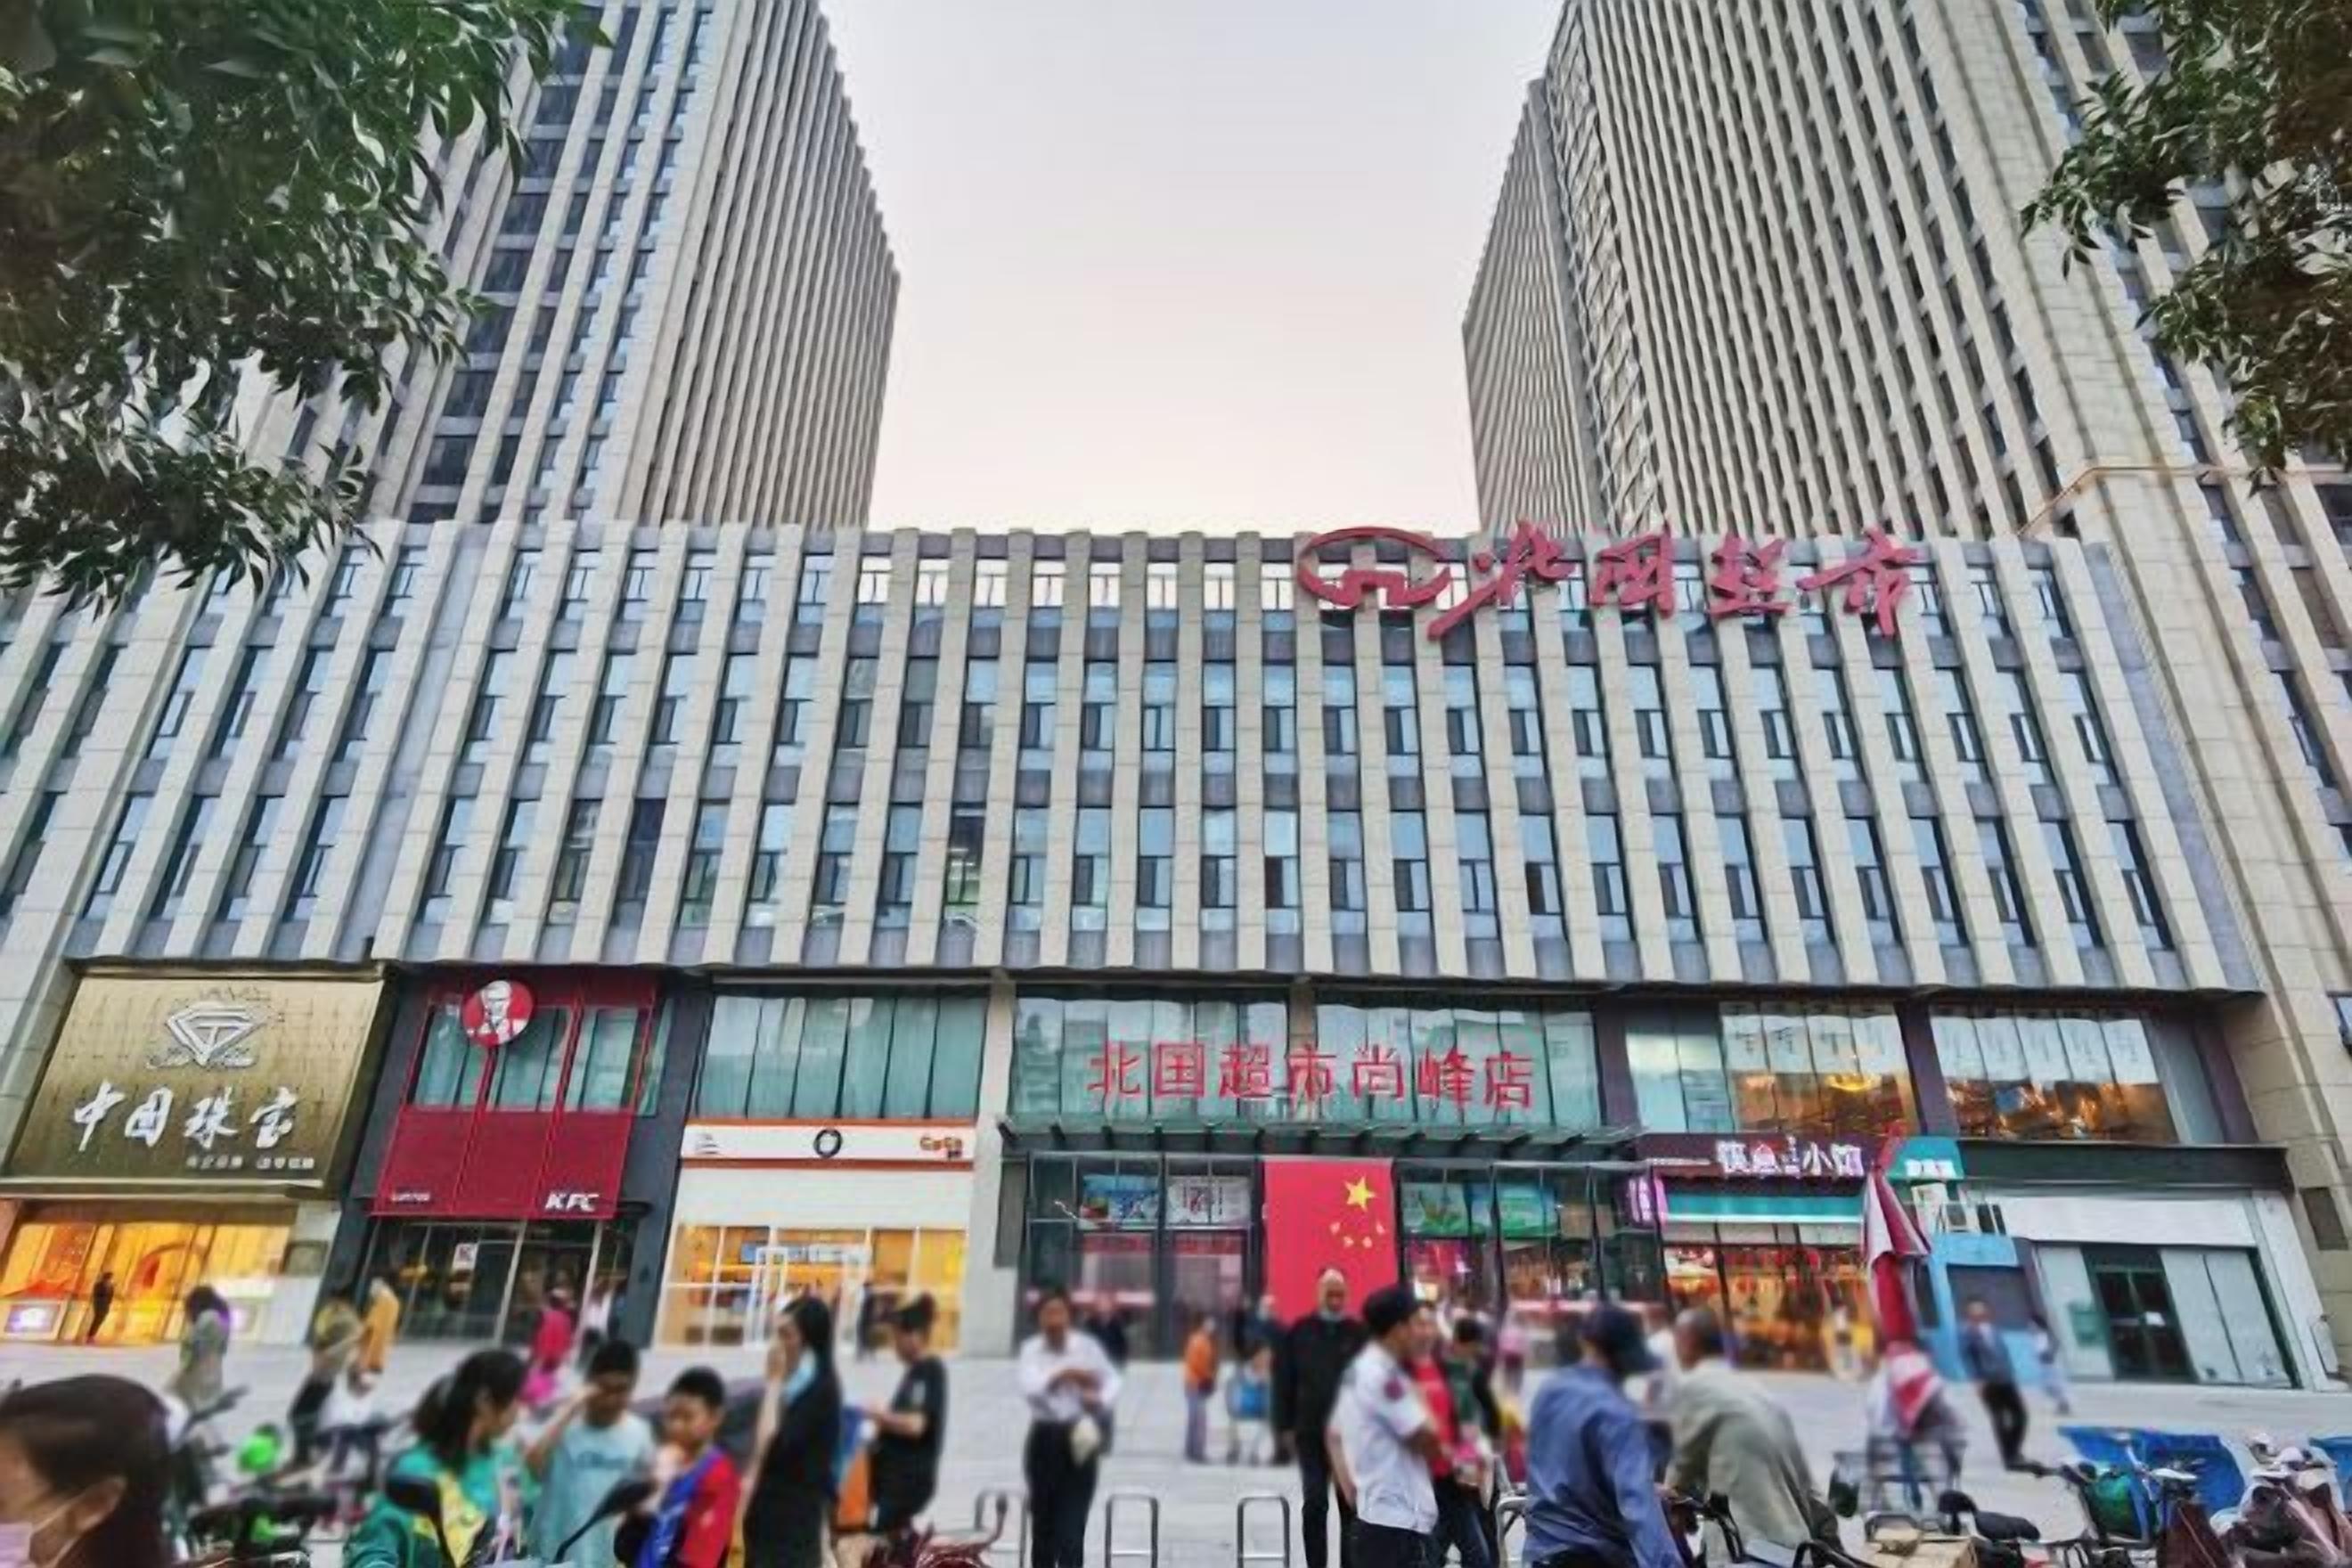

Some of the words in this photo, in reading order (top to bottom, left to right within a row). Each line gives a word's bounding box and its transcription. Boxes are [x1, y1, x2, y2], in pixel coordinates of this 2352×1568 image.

[1088, 1041, 1532, 1108] 北国超市尚峰店
[73, 1080, 300, 1151] 中国珠宝
[544, 1192, 600, 1213] KFC
